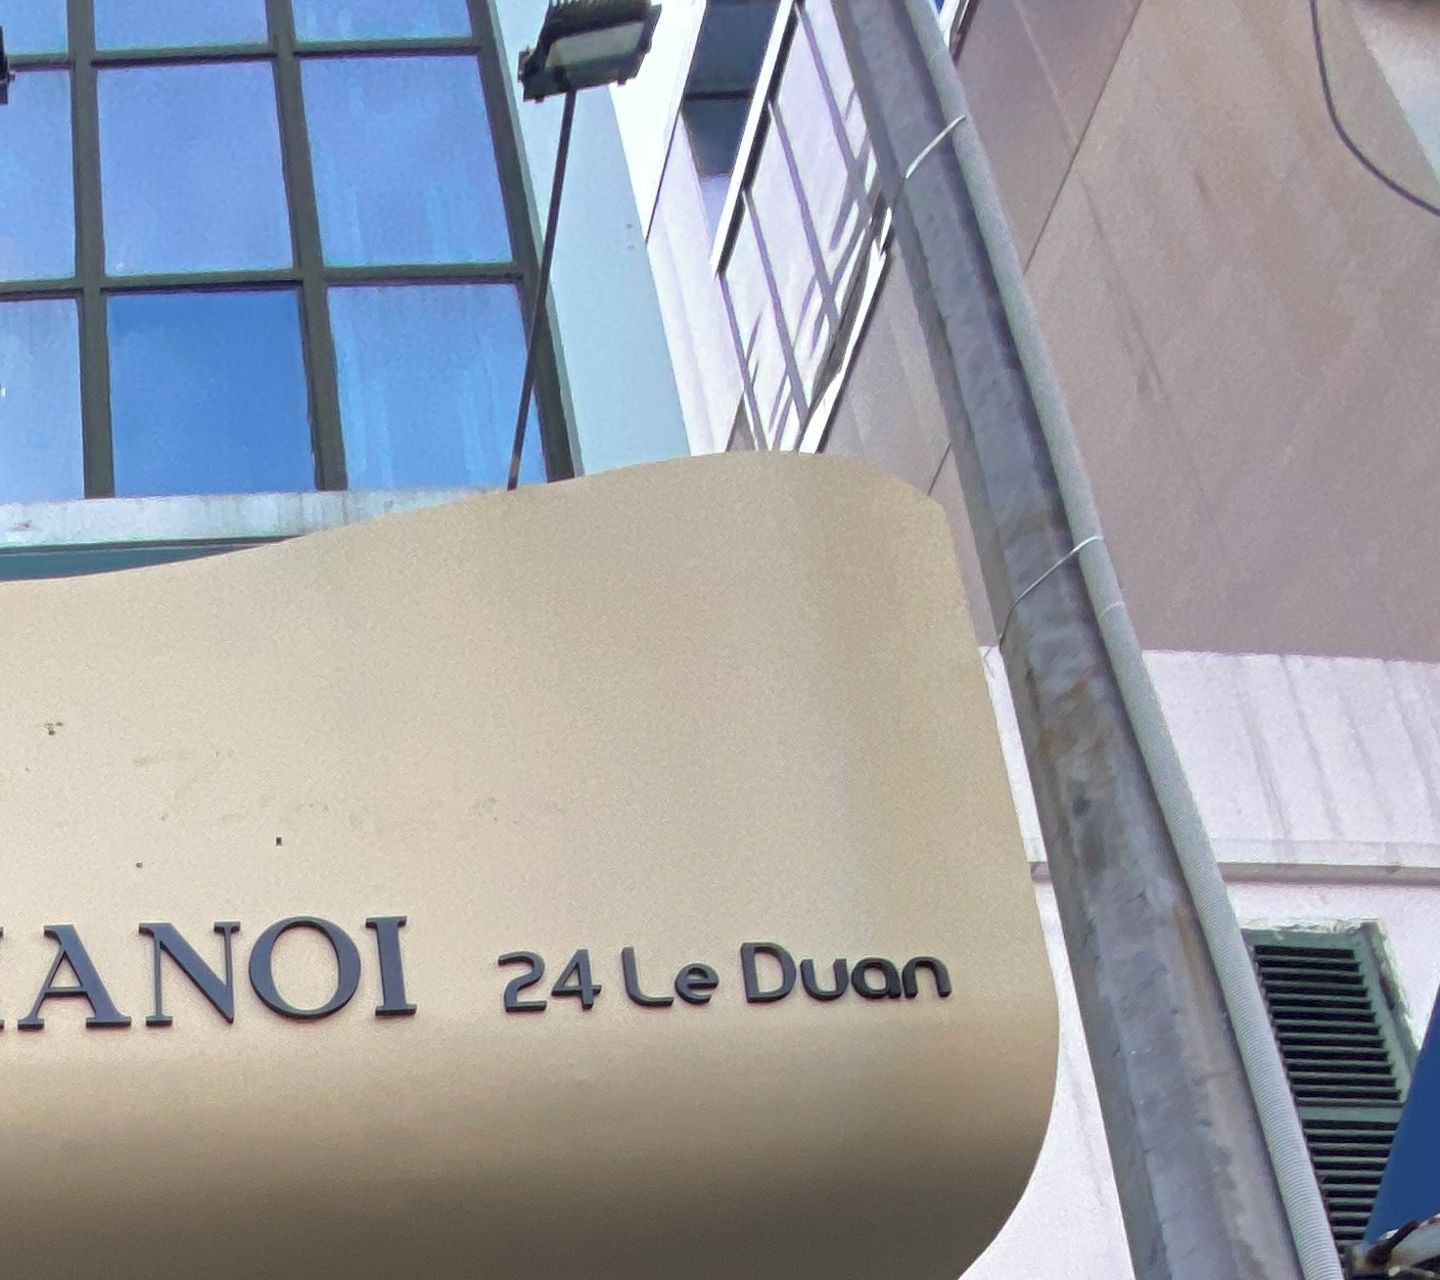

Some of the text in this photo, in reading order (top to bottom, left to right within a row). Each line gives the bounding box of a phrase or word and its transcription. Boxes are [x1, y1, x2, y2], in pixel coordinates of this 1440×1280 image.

[497, 941, 952, 1013] 24 Le Duan
